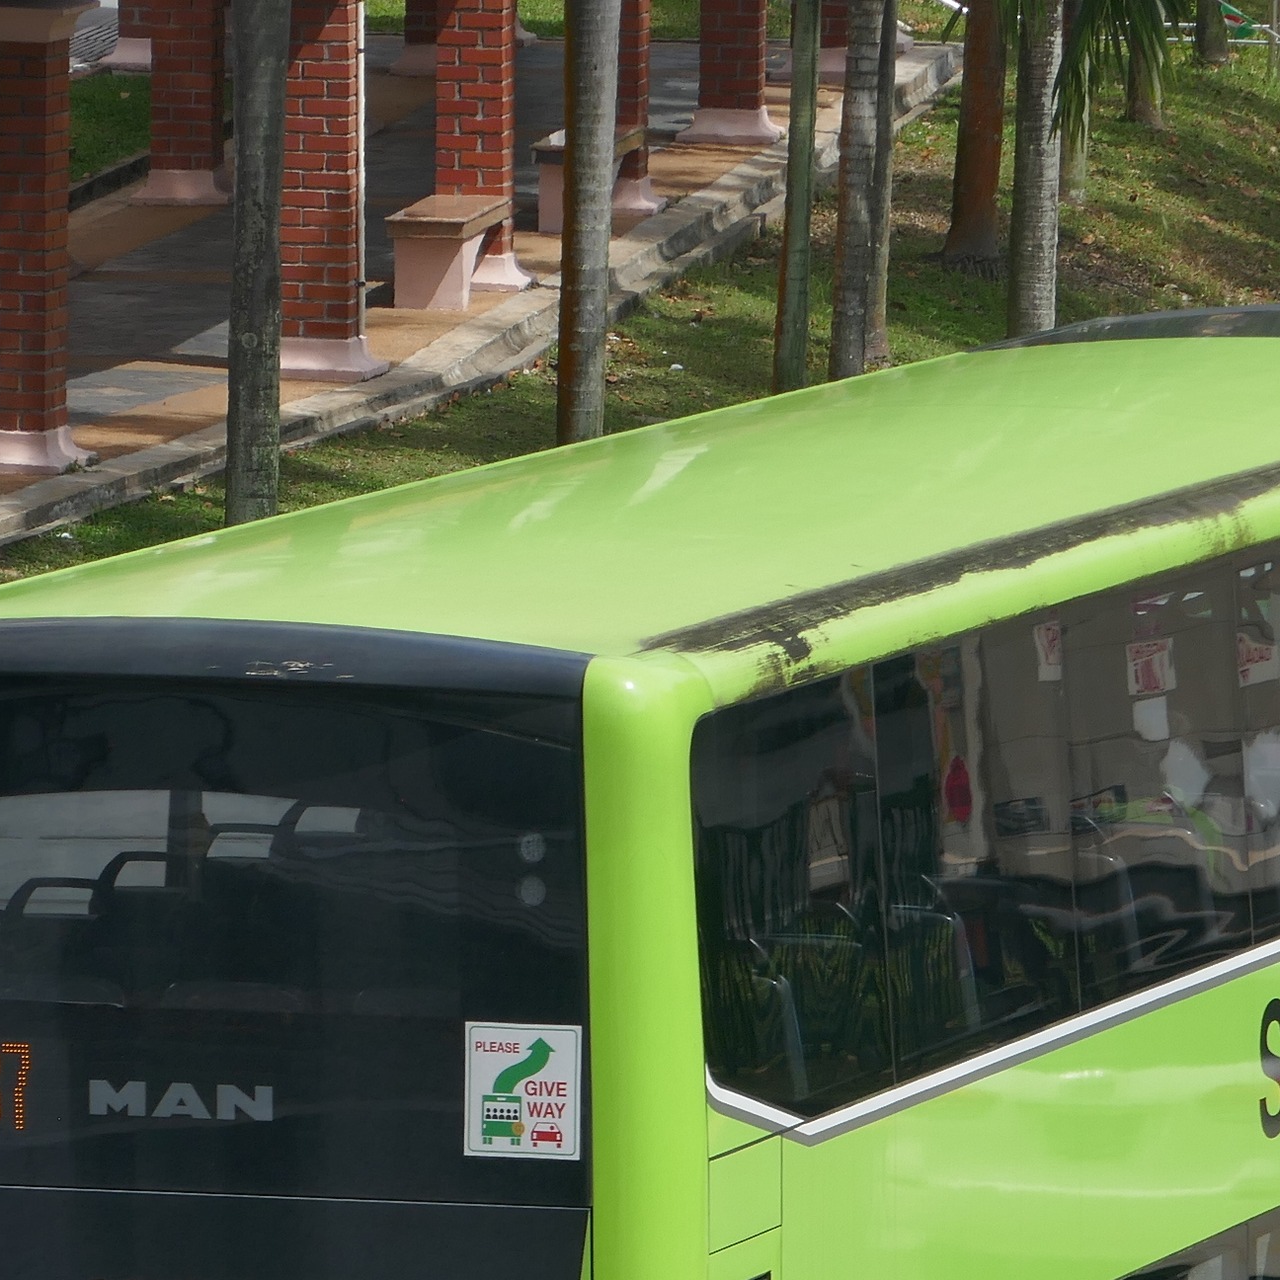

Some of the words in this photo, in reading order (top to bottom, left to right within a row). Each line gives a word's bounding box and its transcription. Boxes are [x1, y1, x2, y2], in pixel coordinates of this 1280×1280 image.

[475, 1041, 520, 1054] PLEASE
[524, 1081, 568, 1097] GIVE
[89, 1079, 273, 1122] MAN
[527, 1102, 566, 1119] WAY
